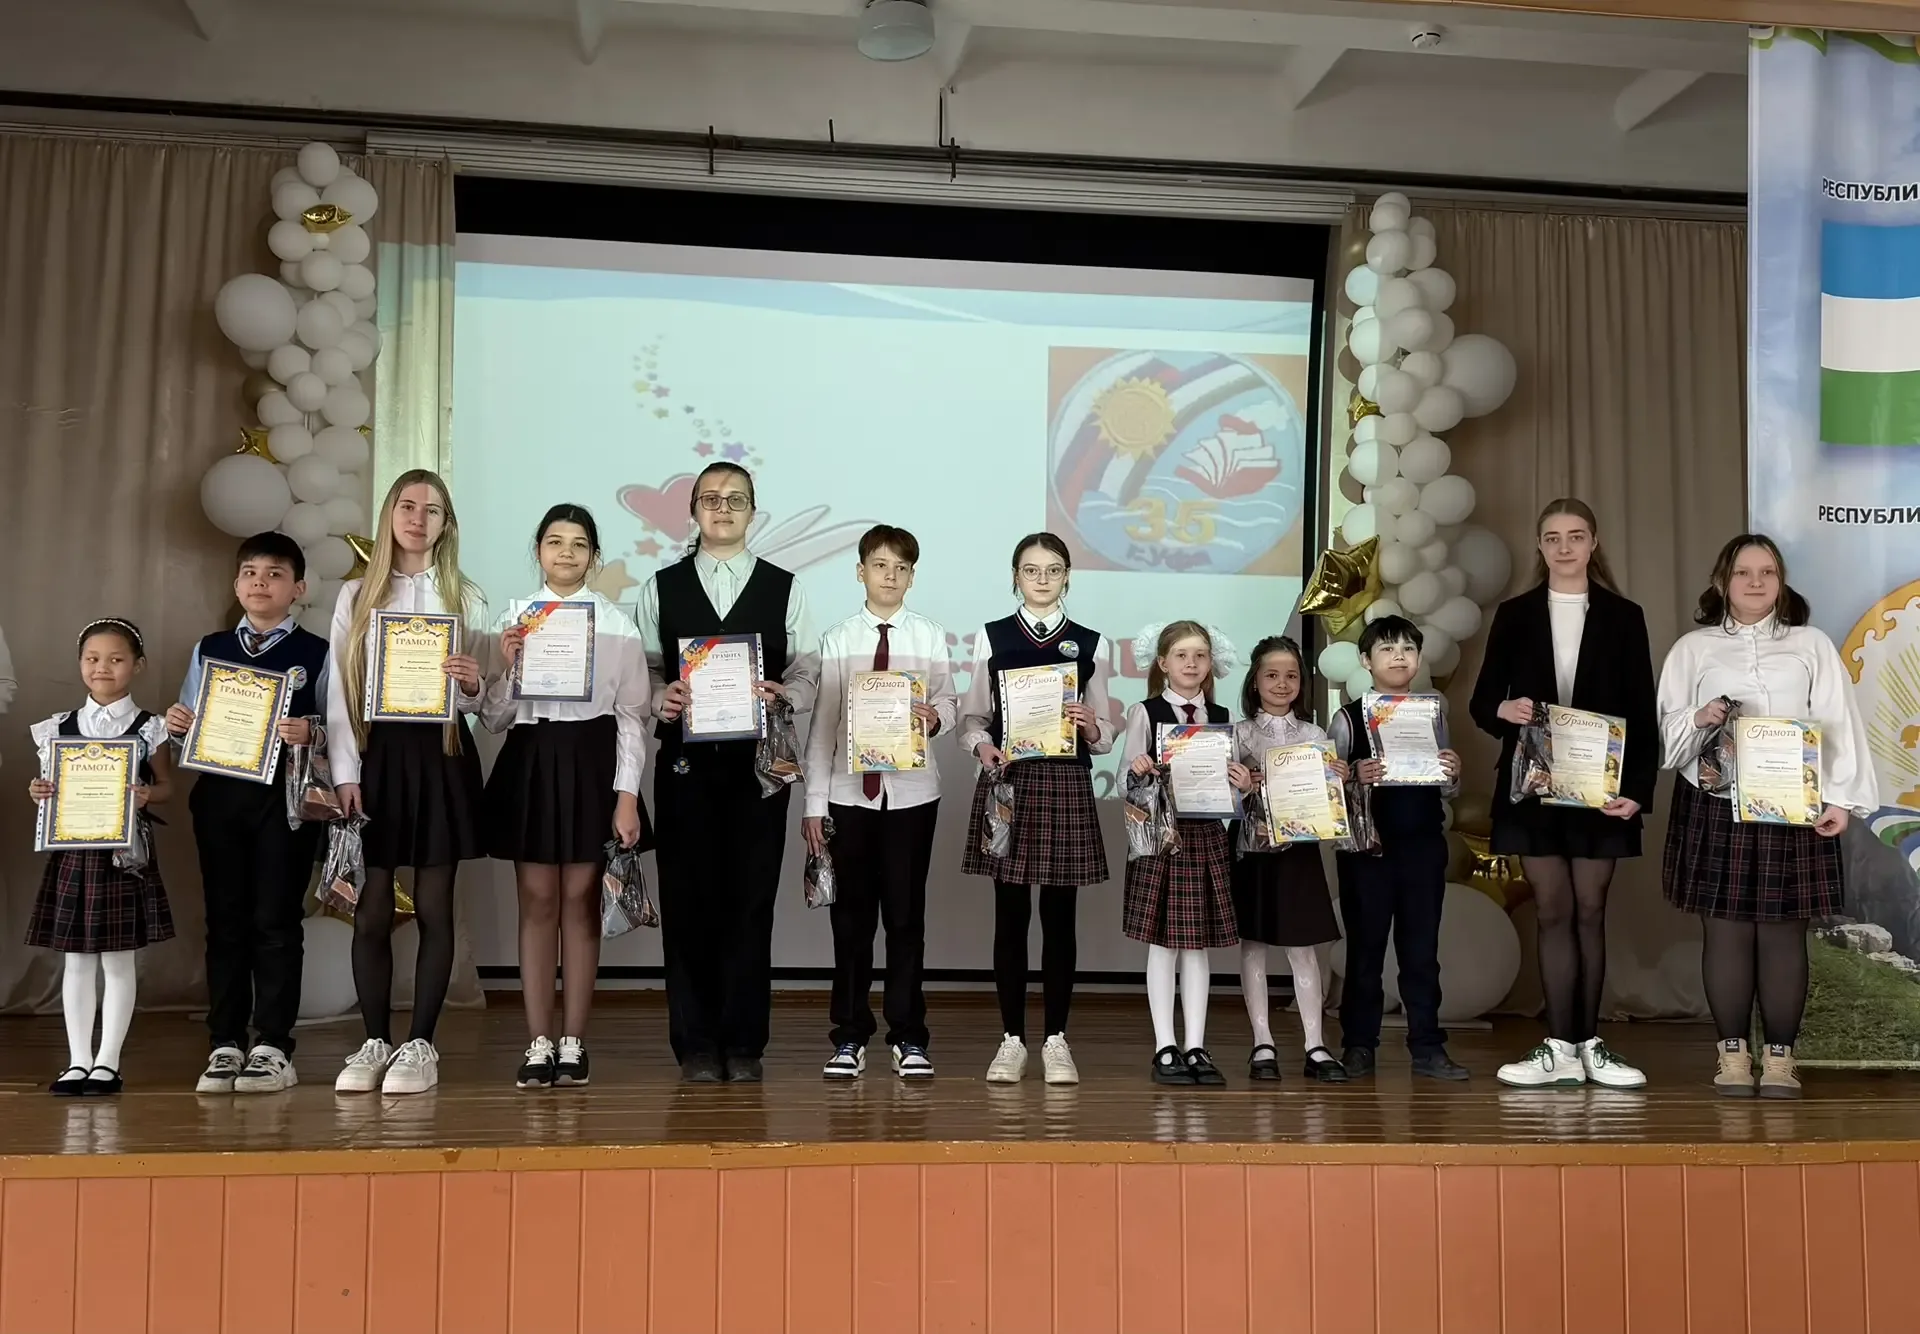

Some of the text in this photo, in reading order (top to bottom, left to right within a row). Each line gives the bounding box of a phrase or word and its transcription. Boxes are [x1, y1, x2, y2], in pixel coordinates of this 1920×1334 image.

[1822, 177, 1918, 202] РЕСПУБЛИ
[1124, 497, 1217, 545] 35
[395, 637, 438, 647] ГРАМОТА
[219, 684, 263, 700] ГРАМОТА
[861, 677, 905, 692] Грамота
[1555, 713, 1603, 729] Грамота
[1746, 724, 1796, 740] Грамота
[1273, 751, 1317, 767] Грамота
[70, 763, 116, 772] ГРАМОТА
